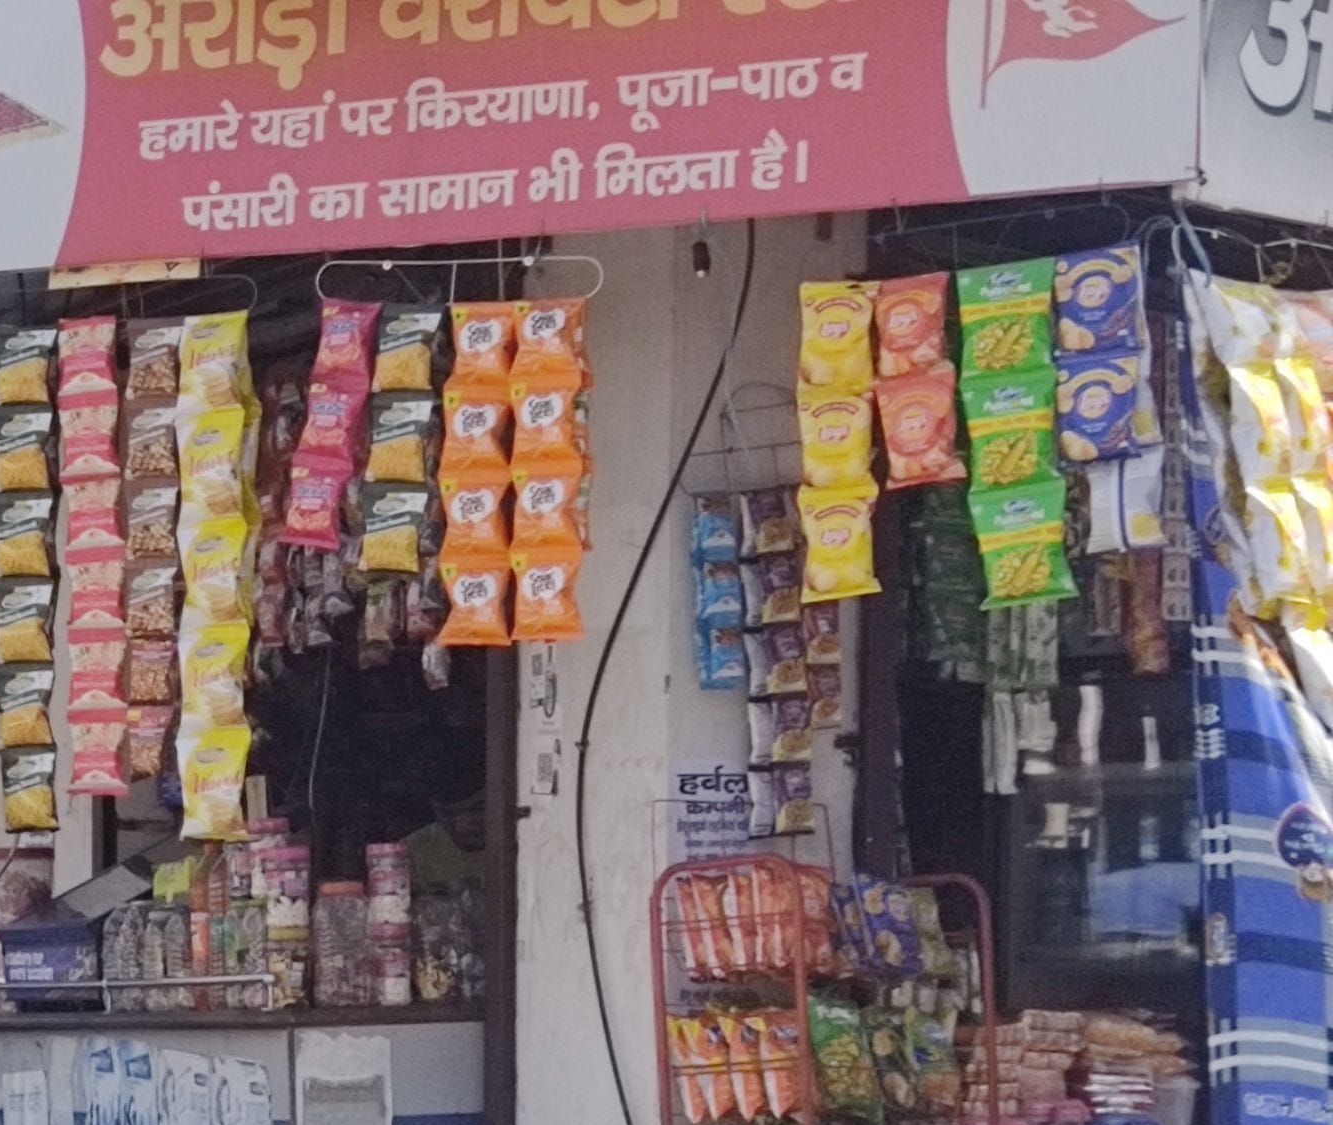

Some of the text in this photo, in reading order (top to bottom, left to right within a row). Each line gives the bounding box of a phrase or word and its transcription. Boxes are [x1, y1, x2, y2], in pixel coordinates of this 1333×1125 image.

[139, 100, 243, 160] हमारे
[251, 90, 336, 149] यहां
[340, 97, 398, 137] पर
[407, 77, 600, 133] किरयाणा,
[829, 52, 869, 92] व
[181, 172, 300, 232] पंसारी
[308, 181, 369, 222] का
[378, 168, 520, 219] सामान
[529, 147, 584, 204] भी
[594, 142, 740, 199] मिलता
